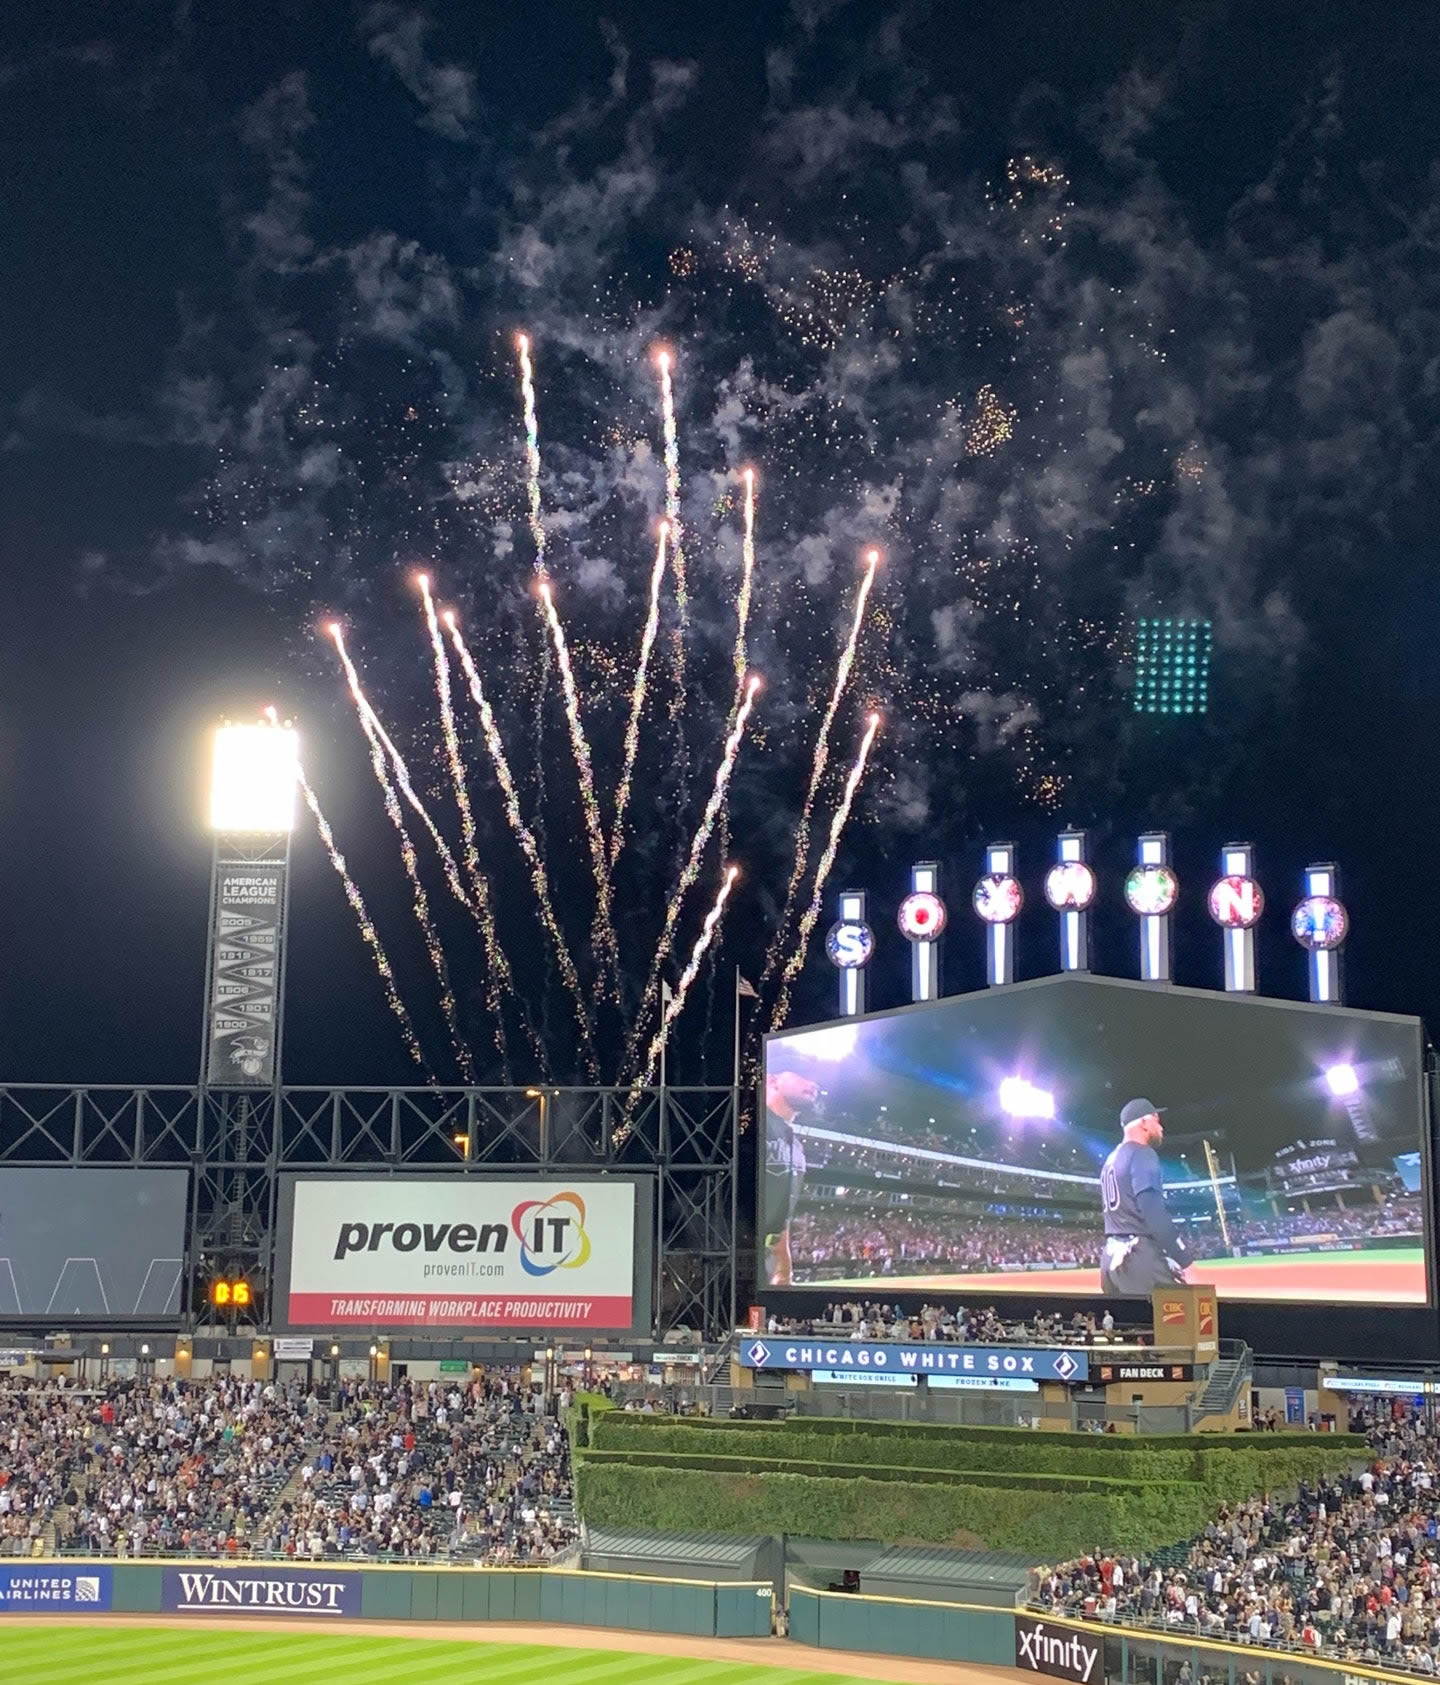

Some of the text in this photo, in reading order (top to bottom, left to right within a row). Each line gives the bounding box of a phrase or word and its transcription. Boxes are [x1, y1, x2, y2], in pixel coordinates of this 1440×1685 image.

[223, 877, 277, 886] AMERICAN
[223, 887, 277, 896] LEAGUE
[222, 897, 276, 905] CHAMPIONS
[333, 1218, 570, 1260] proven IT
[424, 1262, 504, 1277] provenIT.com
[330, 1299, 593, 1319] TRANSFORMING WORKPLACE PRODUCTIVITY
[785, 1348, 1034, 1371] CHICAGO WHITE SOX
[1120, 1368, 1164, 1378] FAN DECK
[10, 1579, 72, 1589] UNITED
[178, 1573, 346, 1607] WINTRUST
[756, 1588, 772, 1597] 400
[1019, 1623, 1098, 1682] xfinity
